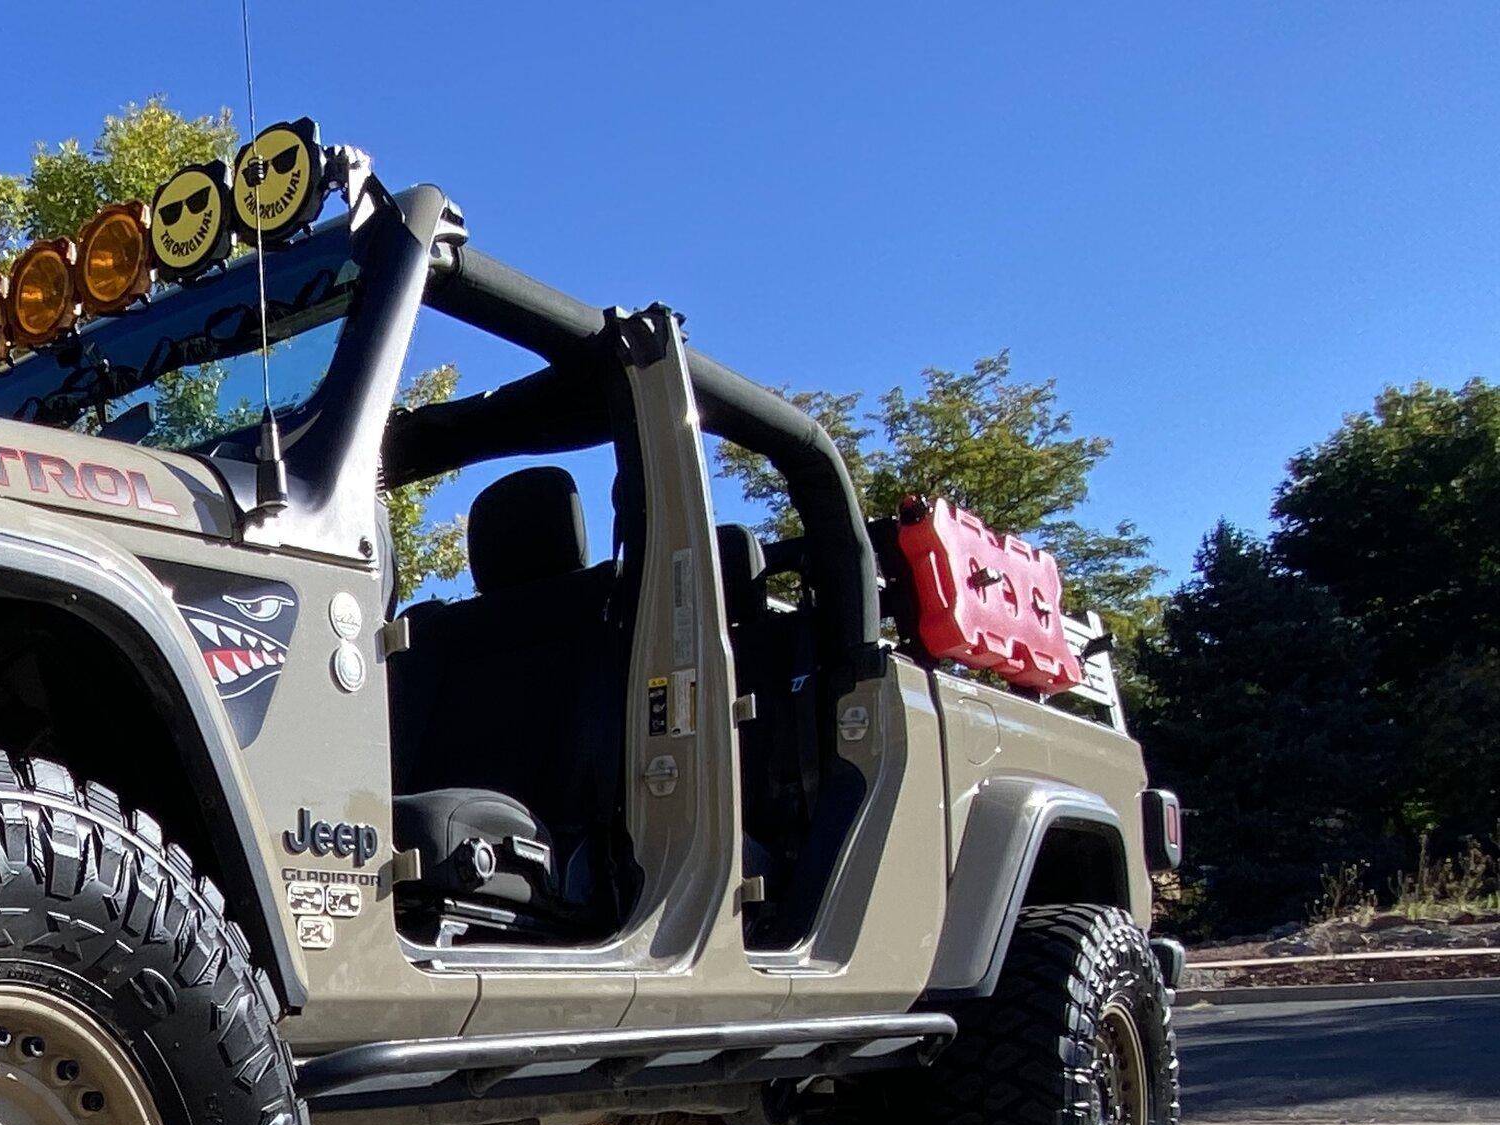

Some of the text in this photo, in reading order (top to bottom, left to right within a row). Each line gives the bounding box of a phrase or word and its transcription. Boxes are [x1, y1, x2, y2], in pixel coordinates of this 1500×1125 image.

[172, 210, 213, 257] ORIGINAL
[281, 807, 379, 869] Jeep
[281, 868, 381, 887] GLADIATOR
